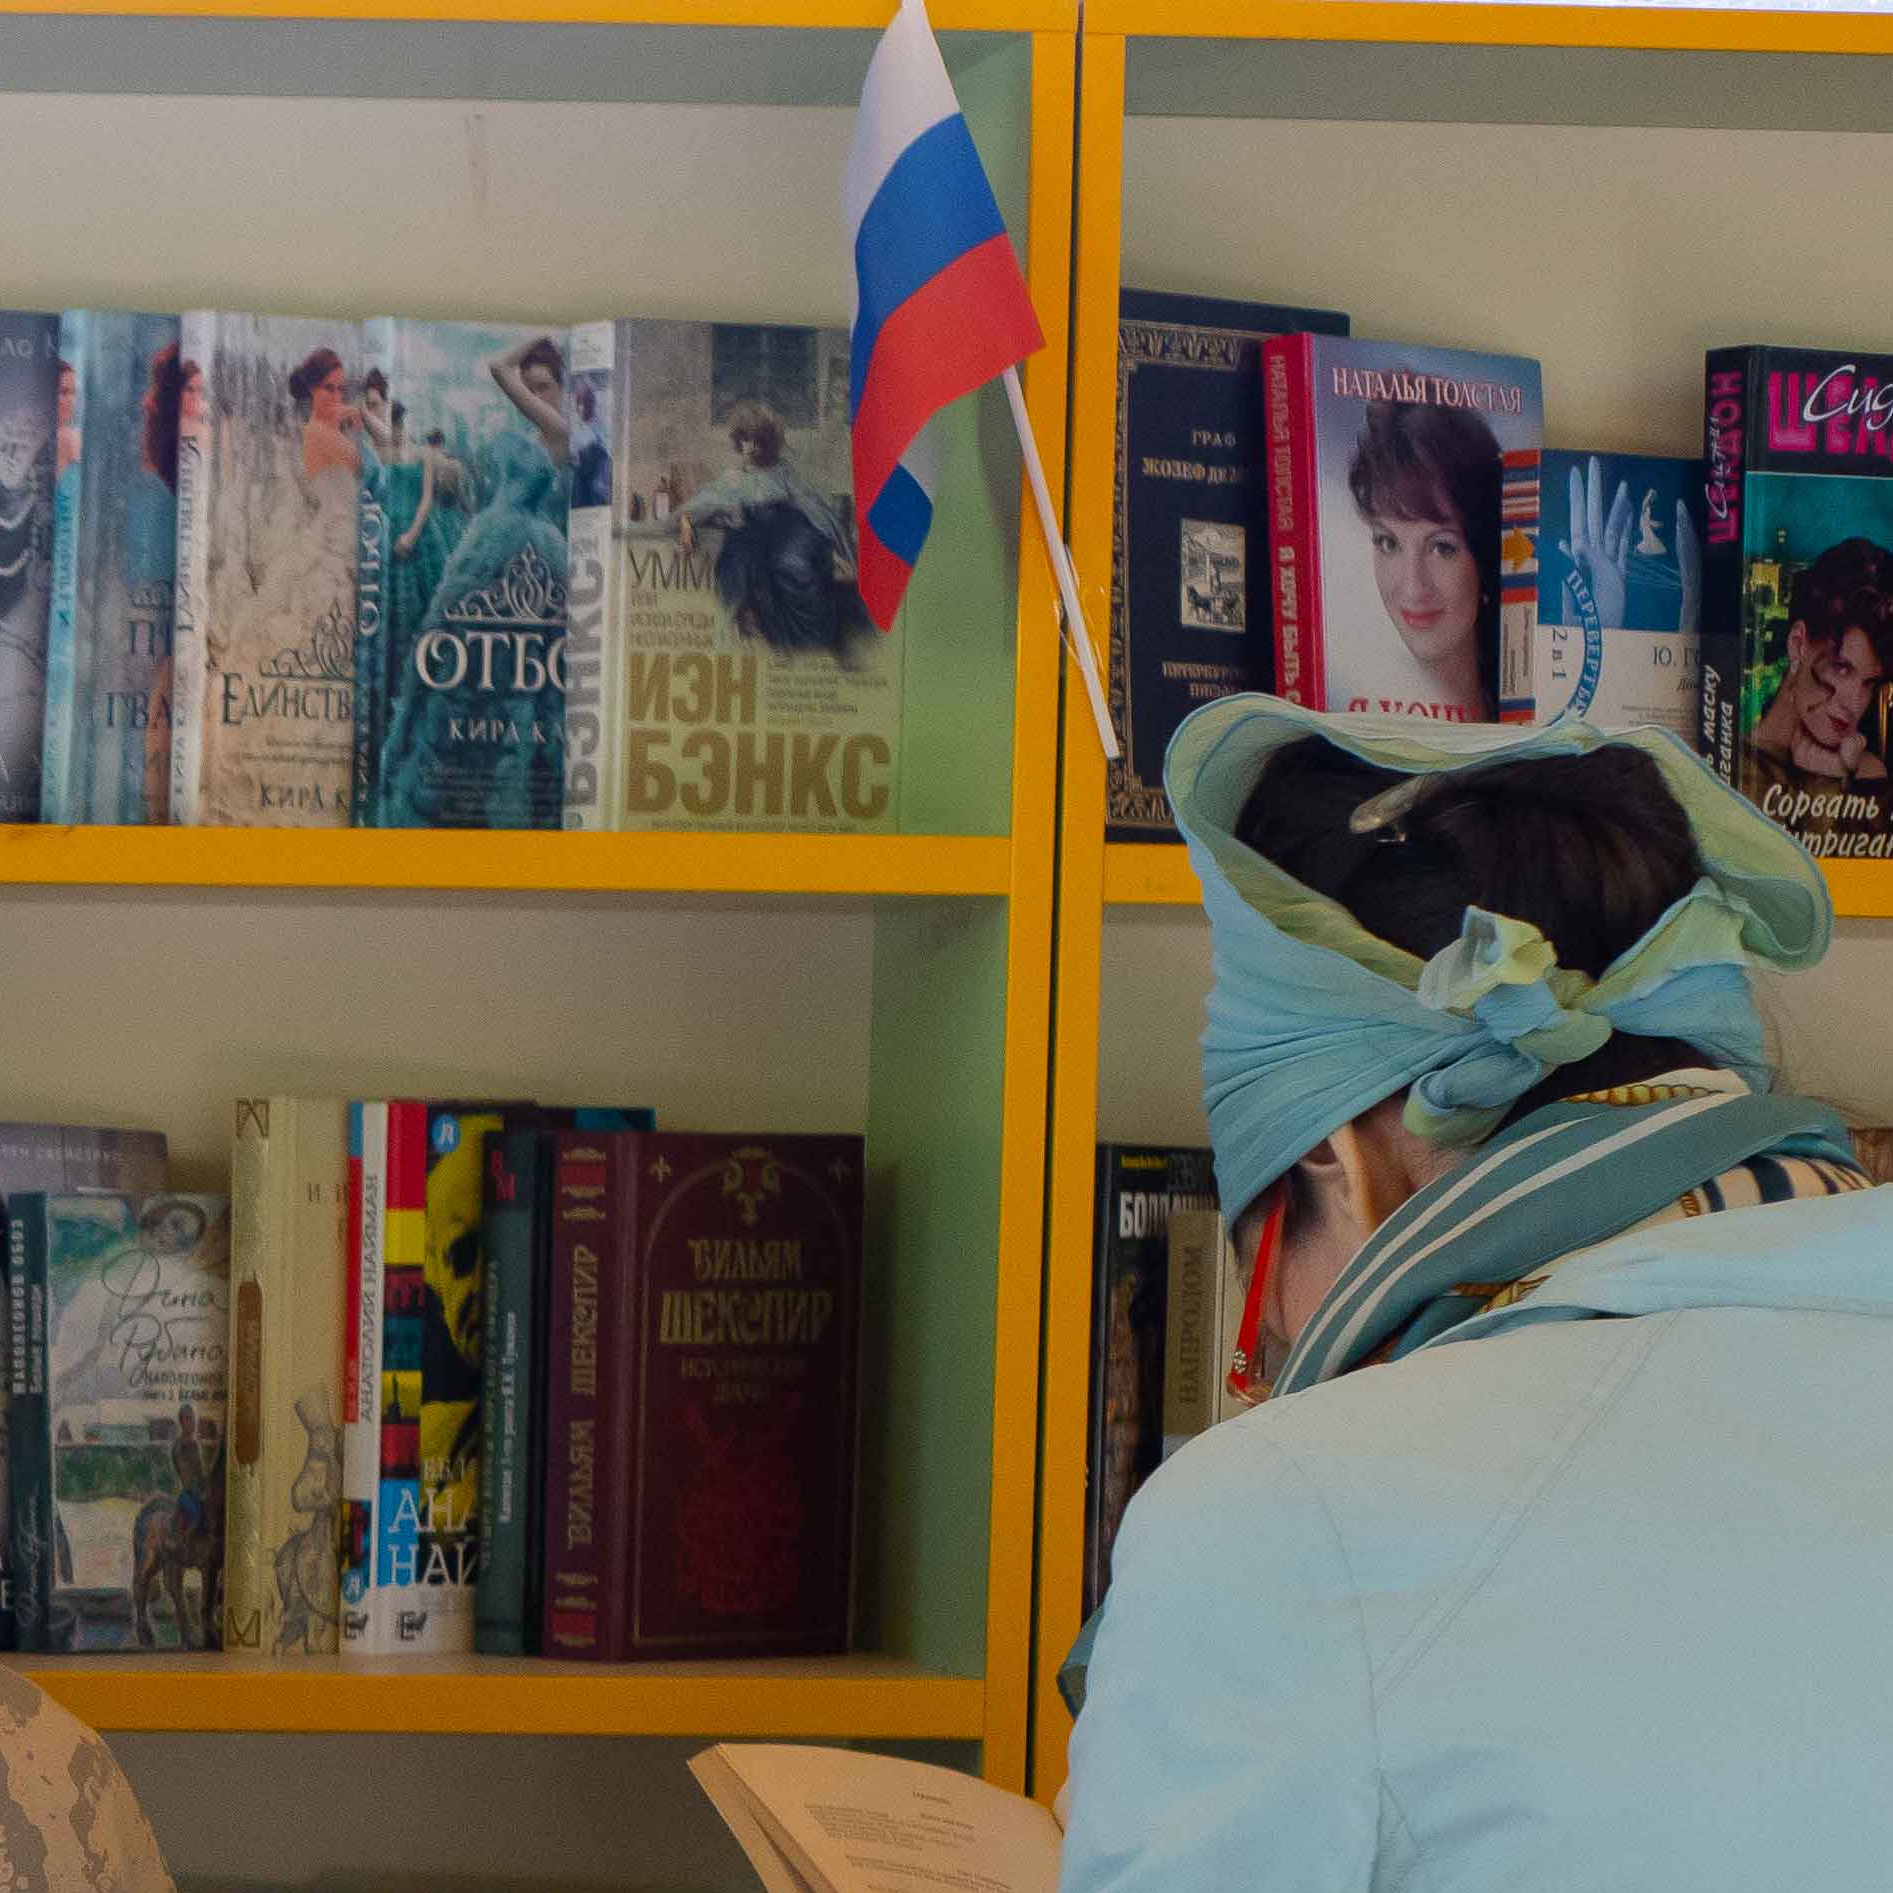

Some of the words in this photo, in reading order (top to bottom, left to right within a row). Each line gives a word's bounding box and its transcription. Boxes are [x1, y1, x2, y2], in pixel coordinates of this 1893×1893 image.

[1270, 355, 1291, 442] НАТАЛЬЯ
[1331, 367, 1427, 402] НАТАЛЬЯ
[1433, 377, 1522, 414] ТОЛСТАЯ
[1767, 371, 1893, 454] ШЕЛ
[628, 652, 757, 725] ИЭН
[1702, 663, 1722, 743] маску
[449, 717, 520, 745] КИРА
[626, 728, 892, 820] БЭНКС
[1763, 782, 1880, 826] Сорвать
[363, 1172, 380, 1284] НАЙМАН
[686, 1236, 802, 1282] ВИЛЬЯМ
[569, 1243, 599, 1396] ШЕКСПИР
[658, 1289, 834, 1346] ШЕКСПИР
[359, 1293, 378, 1423] АНАТОЛИЙ
[388, 1487, 468, 1533] АН
[567, 1418, 596, 1550] ВИЛЬЯМ
